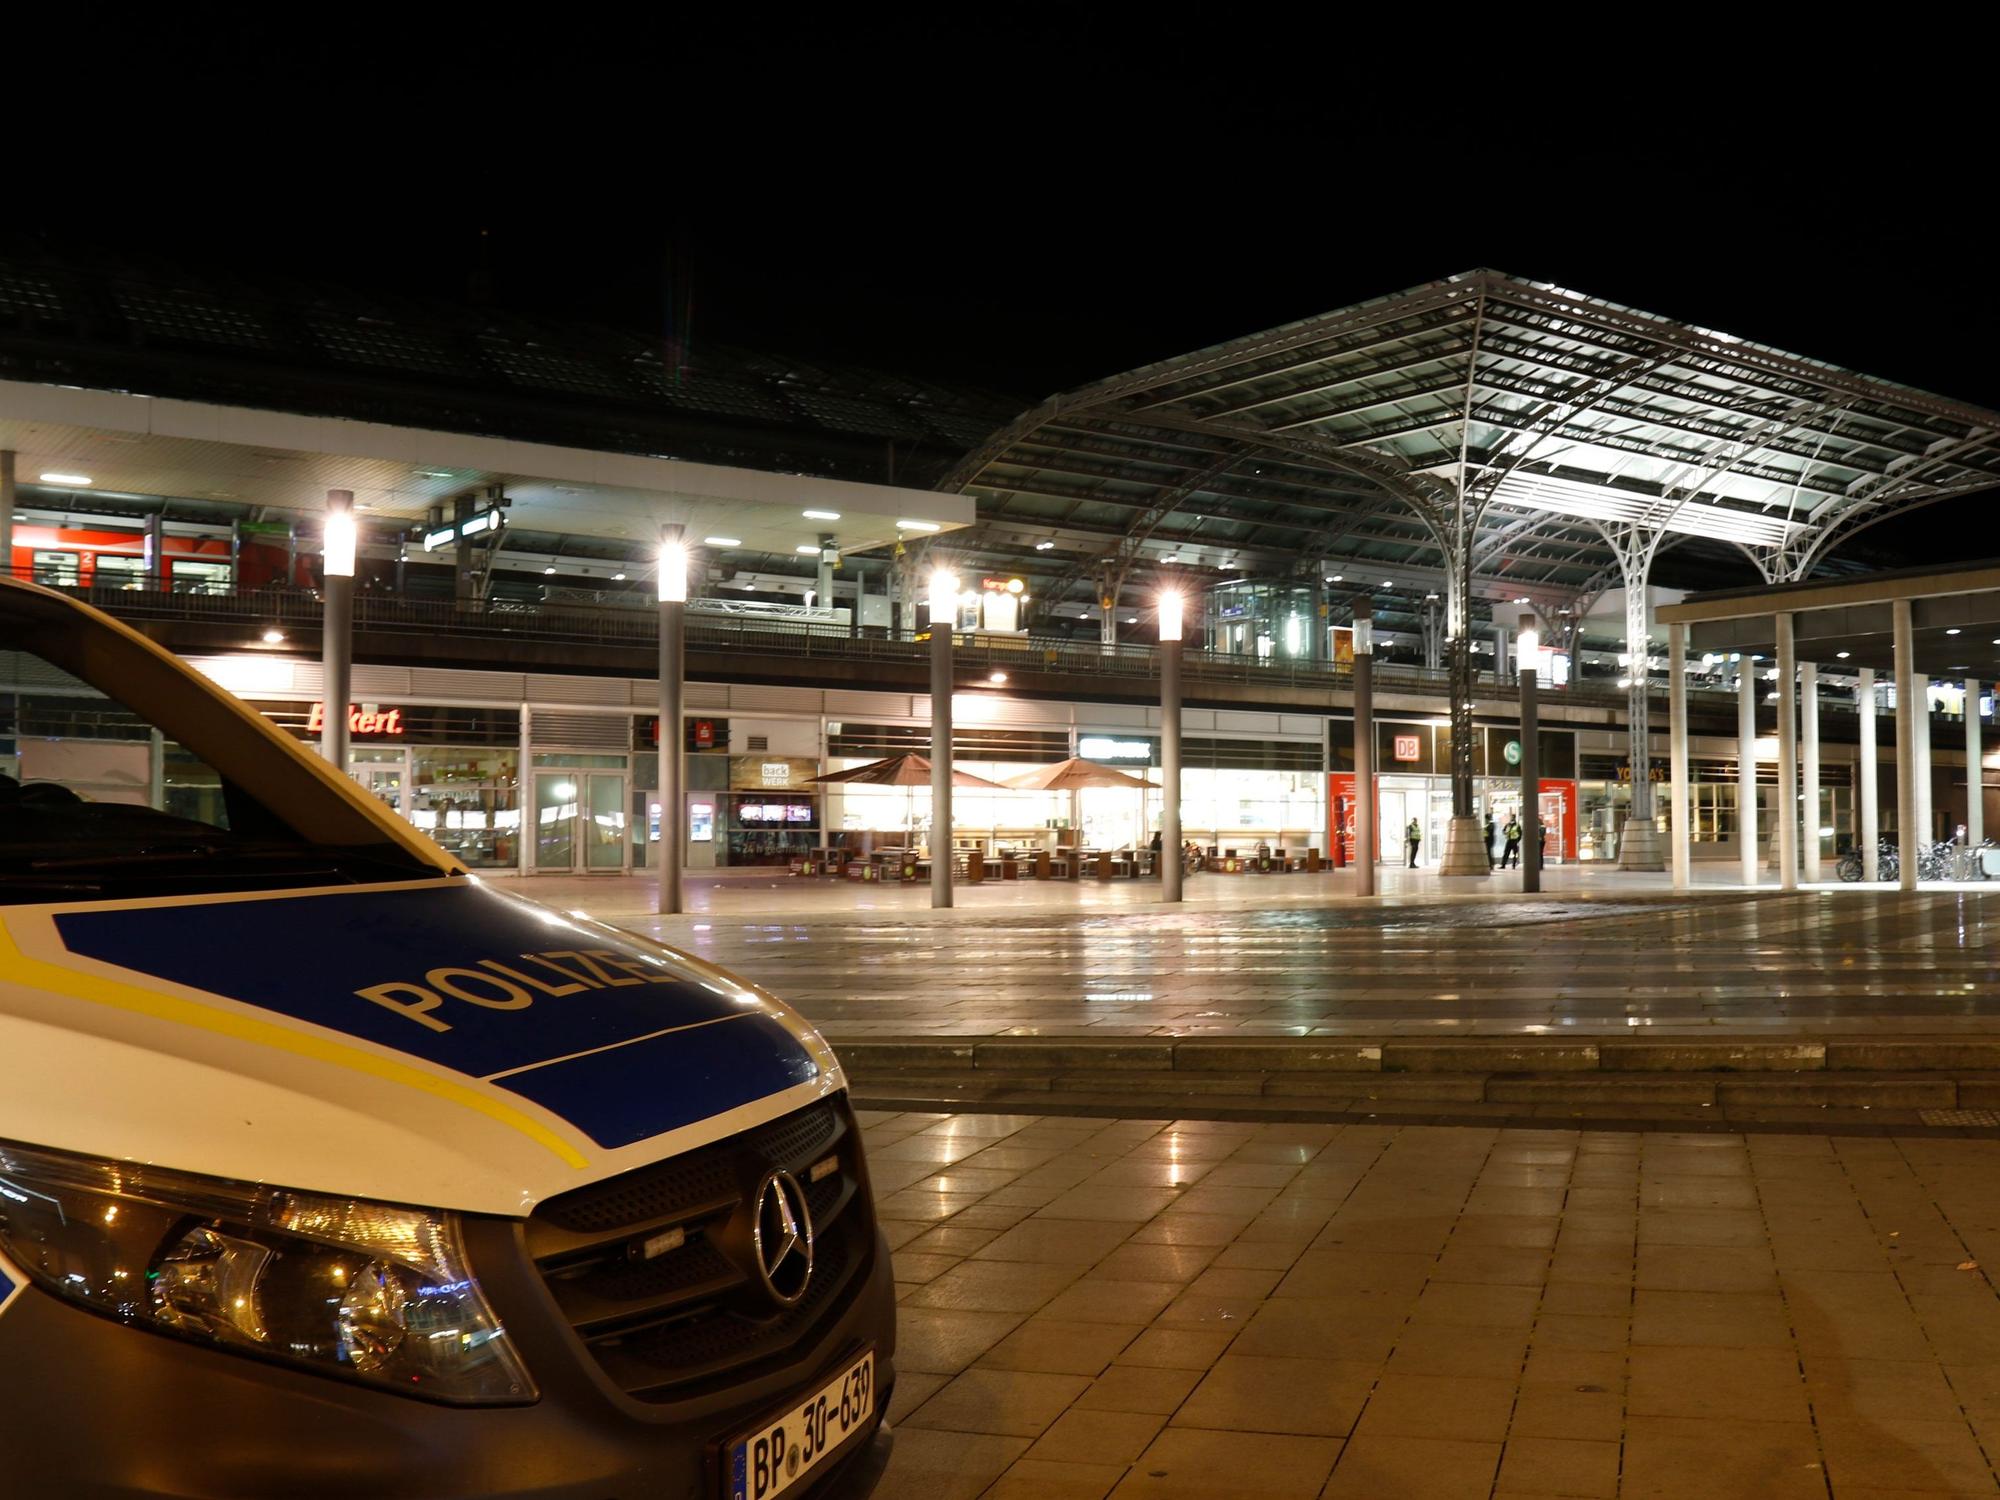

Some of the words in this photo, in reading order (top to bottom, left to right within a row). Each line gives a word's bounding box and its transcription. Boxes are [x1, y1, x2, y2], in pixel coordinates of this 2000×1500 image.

[308, 703, 403, 733] Ekert.
[1398, 740, 1416, 756] DB
[764, 765, 787, 775] back
[1616, 767, 1664, 781] YOA'S
[754, 1426, 785, 1500] BP
[803, 1360, 870, 1463] 30-639
